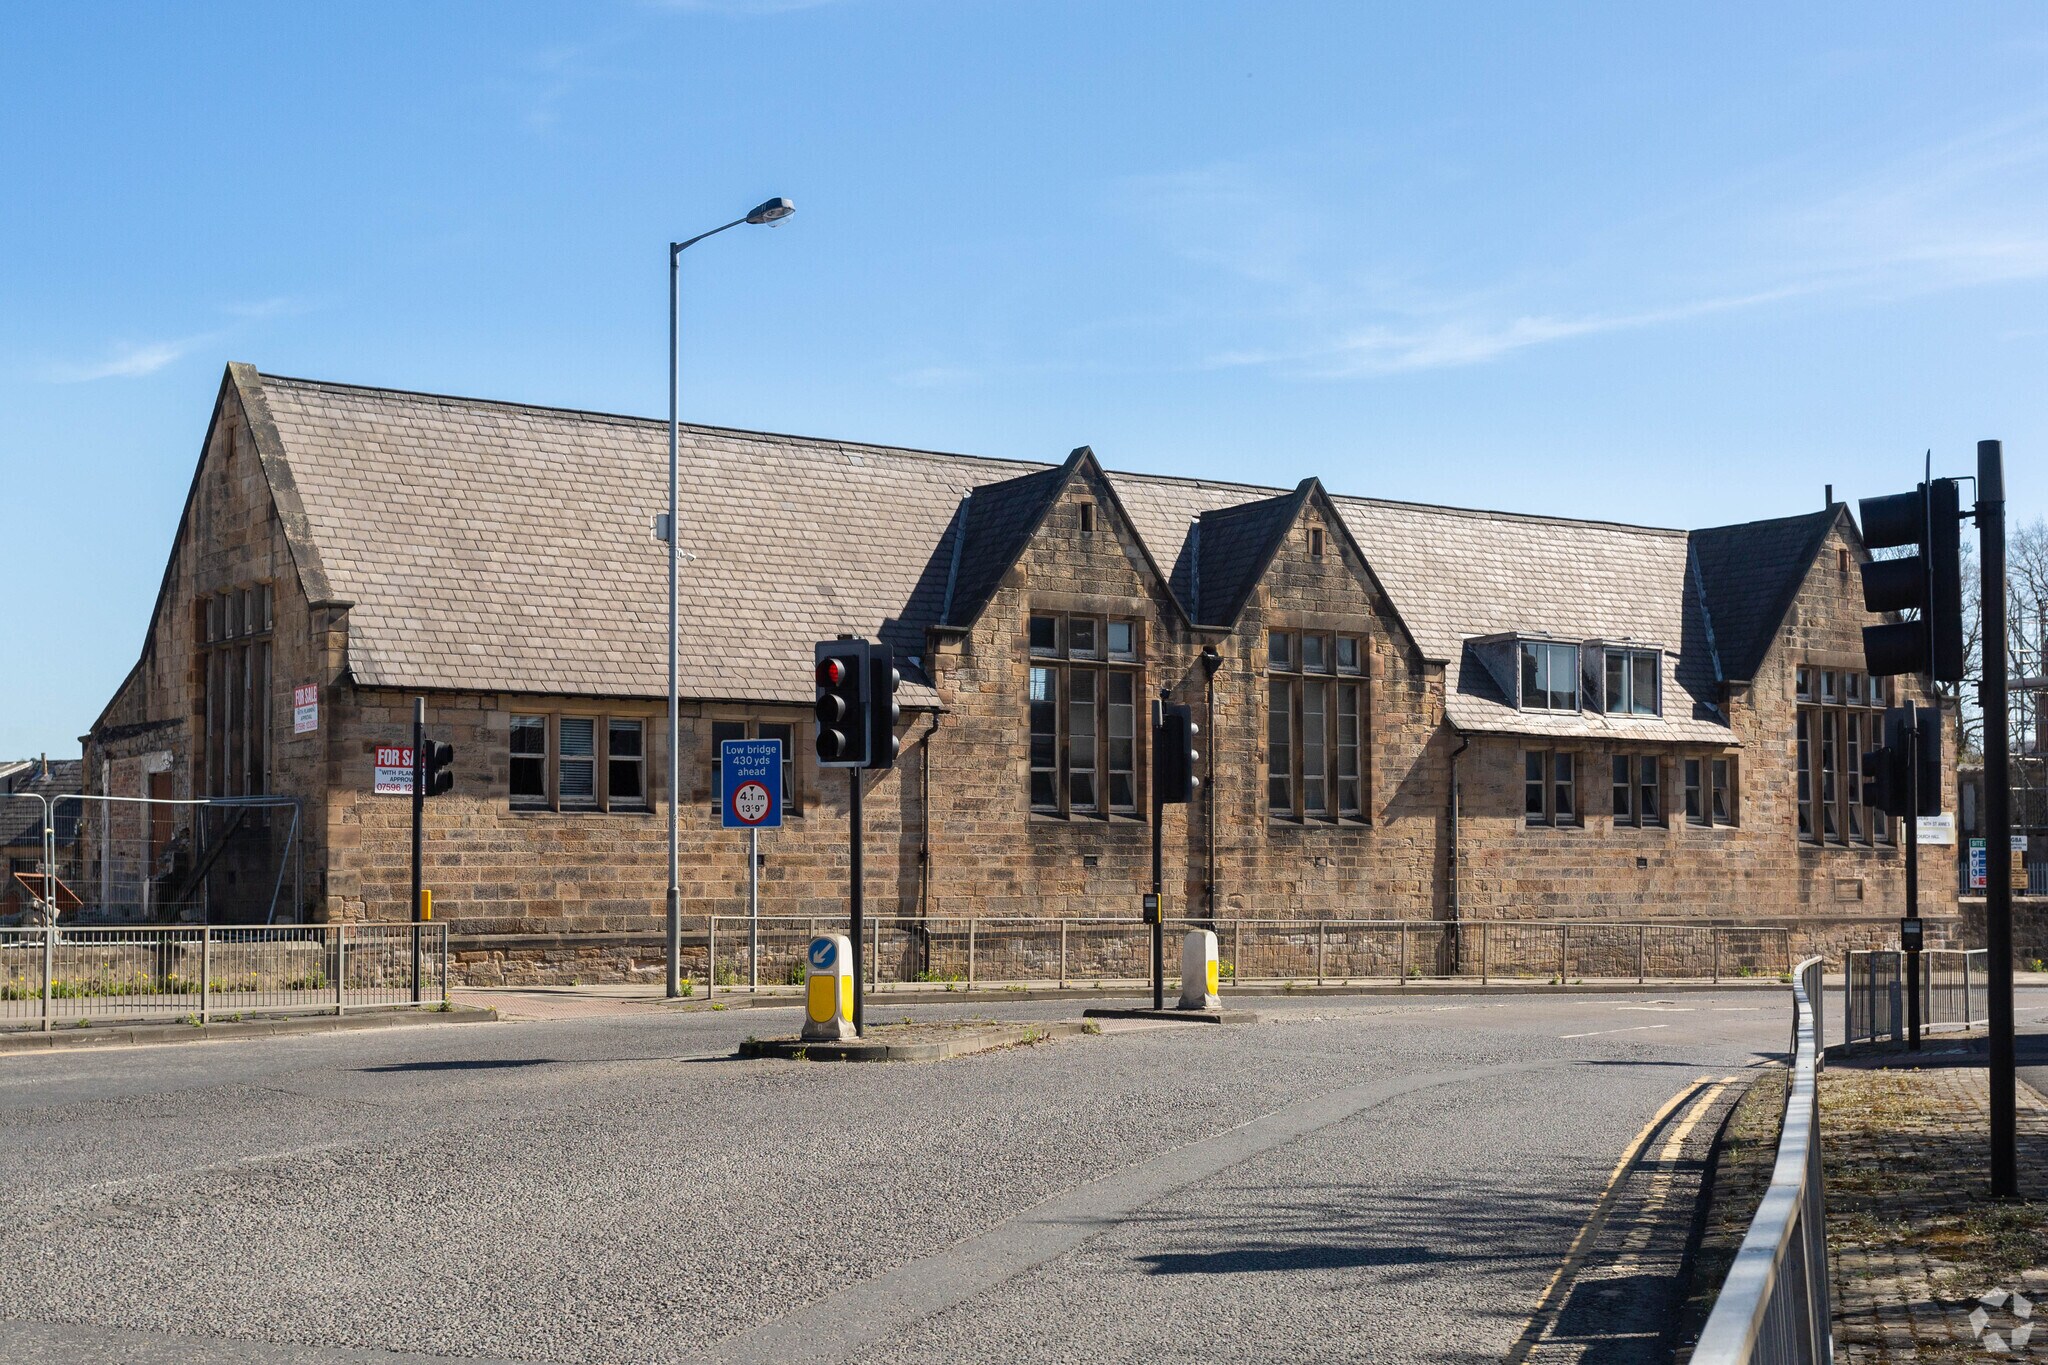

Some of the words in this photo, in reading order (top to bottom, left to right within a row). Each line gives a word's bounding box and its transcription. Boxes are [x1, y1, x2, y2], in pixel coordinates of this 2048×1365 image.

[295, 689, 304, 706] FOR
[305, 686, 317, 703] SALE
[726, 745, 744, 754] Low
[747, 745, 776, 755] bridge
[378, 749, 400, 766] FOR
[733, 756, 752, 765] 430
[754, 756, 770, 766] yds
[737, 767, 766, 776] ahead
[376, 783, 401, 791] 07596
[740, 791, 754, 801] 4.1
